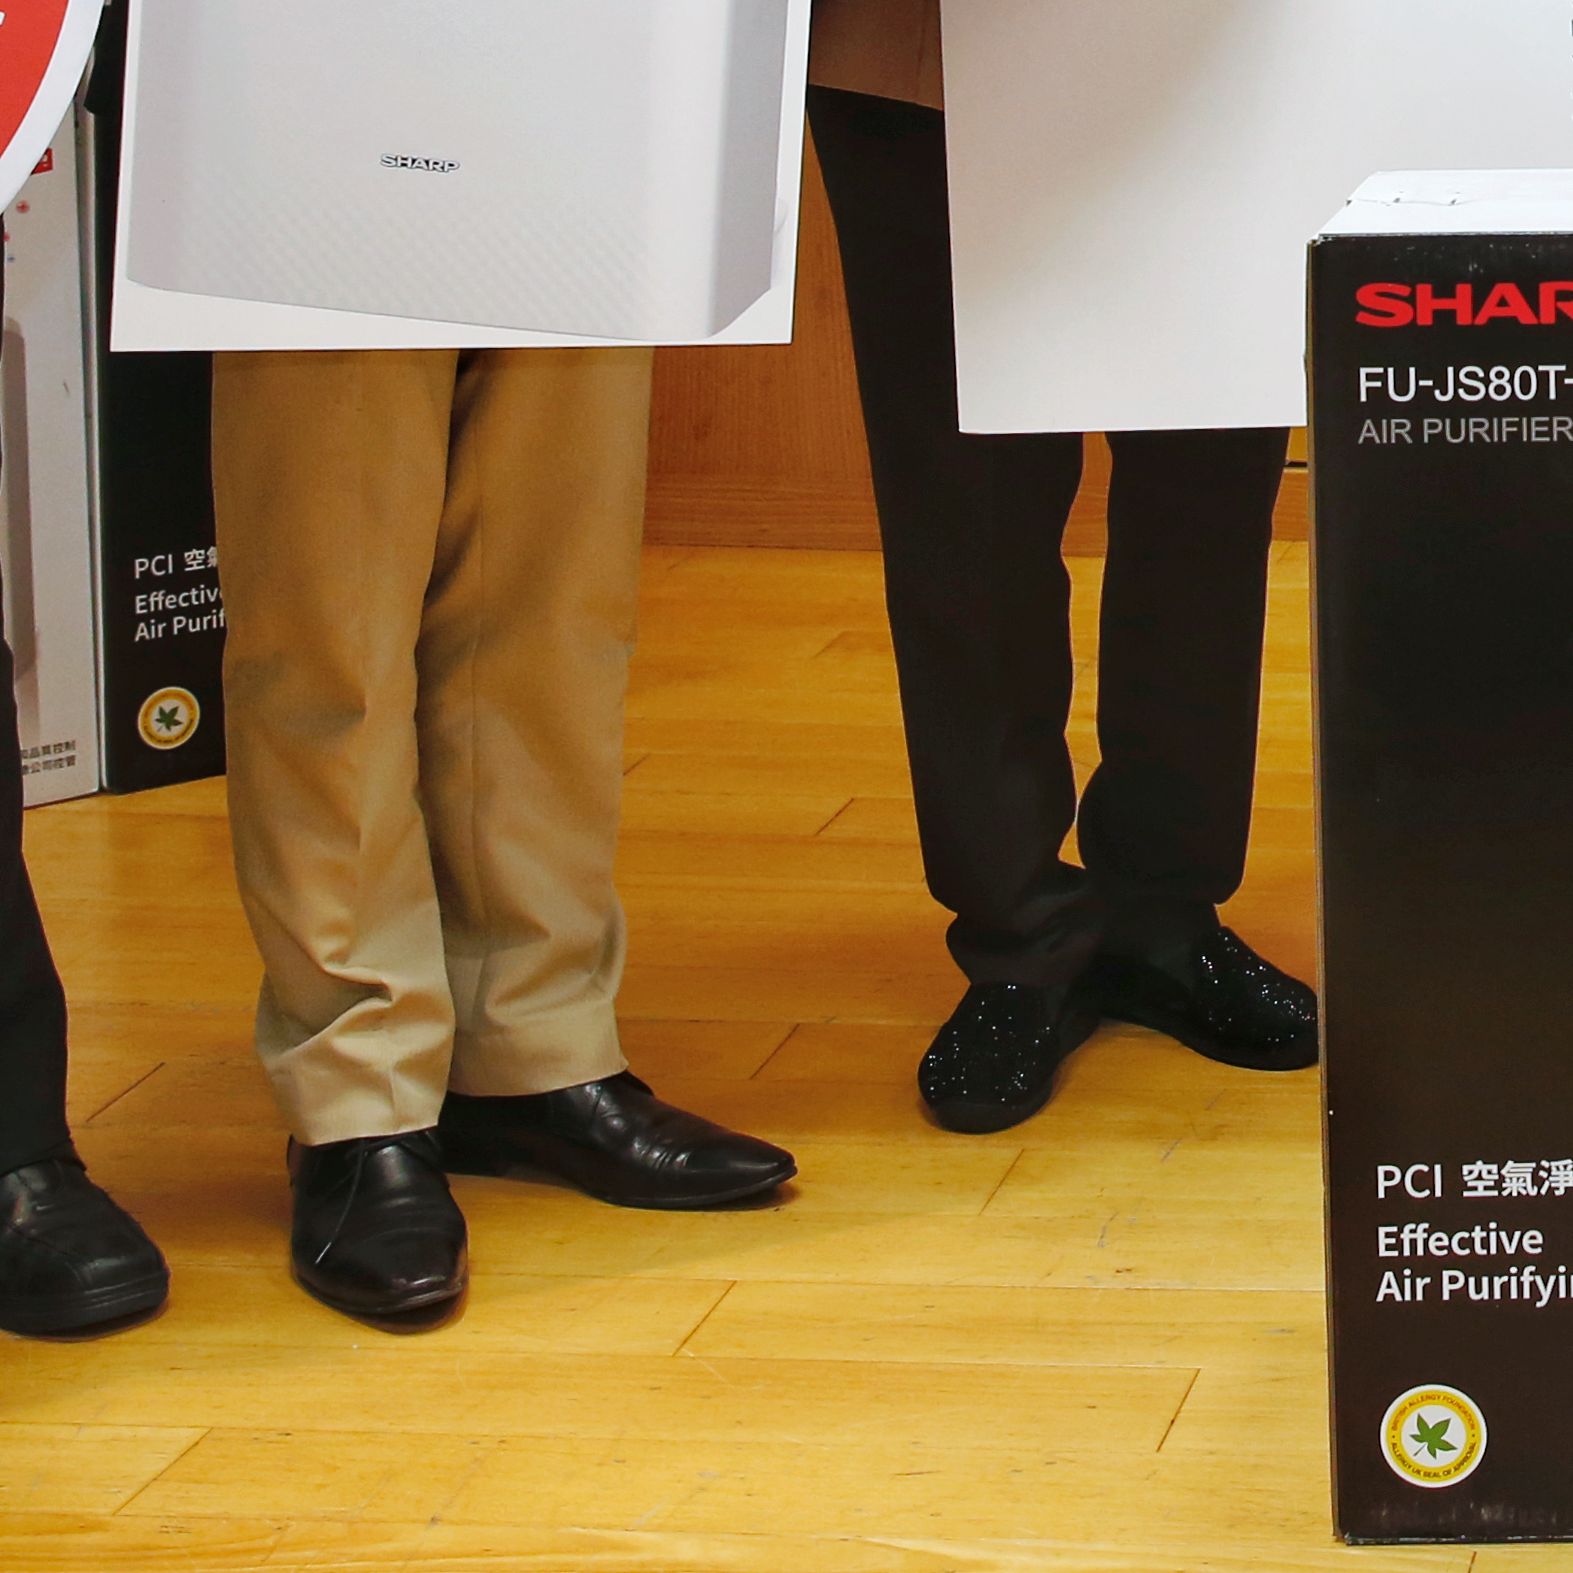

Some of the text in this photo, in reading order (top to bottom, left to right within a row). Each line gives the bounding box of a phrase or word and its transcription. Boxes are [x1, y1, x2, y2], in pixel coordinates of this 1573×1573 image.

[380, 154, 460, 173] SHARP
[1359, 419, 1413, 445] AIR
[134, 554, 173, 579] PCI
[135, 584, 222, 615] Effectiv
[134, 619, 167, 642] Air
[1376, 1164, 1443, 1199] PCI
[1377, 1221, 1544, 1257] Effective
[1375, 1268, 1432, 1303] Air
